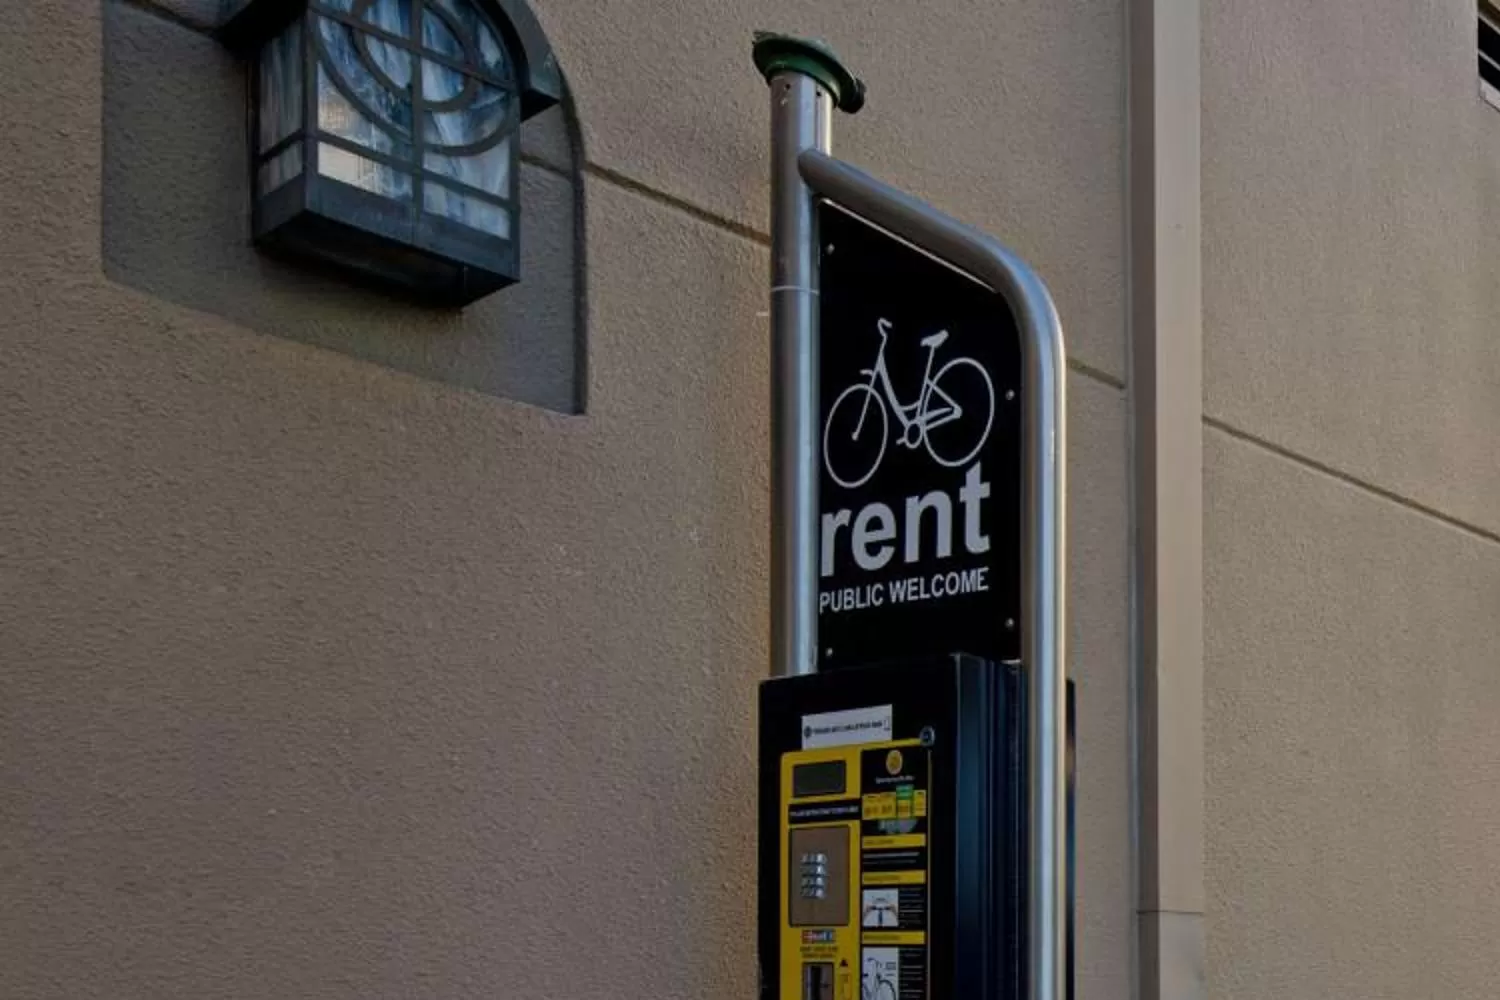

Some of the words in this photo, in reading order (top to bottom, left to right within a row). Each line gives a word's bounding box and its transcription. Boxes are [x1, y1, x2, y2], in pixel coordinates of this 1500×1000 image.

[821, 461, 990, 577] rent
[819, 583, 884, 615] PUBLIC
[889, 567, 989, 603] WELCOME
